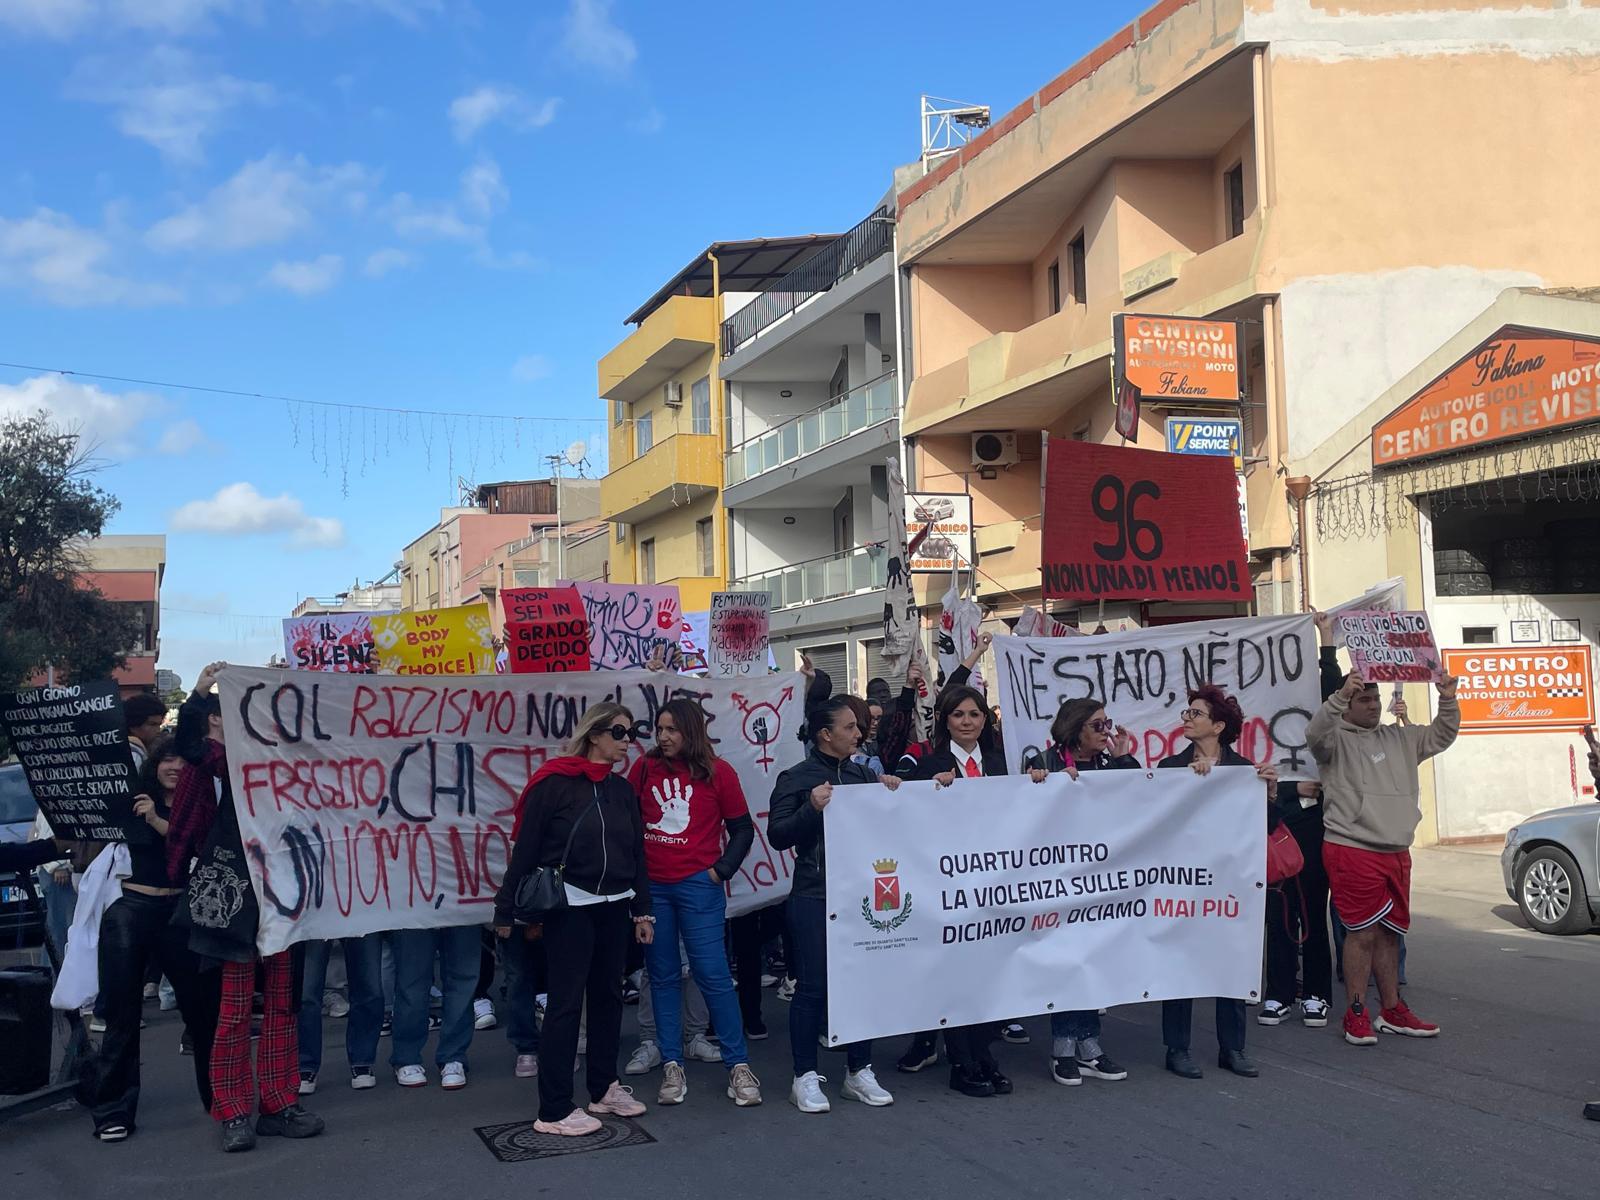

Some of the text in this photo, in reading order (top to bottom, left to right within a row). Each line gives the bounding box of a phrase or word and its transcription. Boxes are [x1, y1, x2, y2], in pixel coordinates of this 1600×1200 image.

[1138, 321, 1224, 342] CENTRO
[1129, 338, 1234, 359] REVISIONI
[1205, 362, 1235, 372] MOTO
[1472, 343, 1546, 386] Fabiana
[1157, 371, 1208, 395] Fabiana
[1420, 380, 1534, 422] AUTOVEICOLI
[1193, 425, 1236, 438] POINT
[1379, 412, 1489, 459] CENTRO
[1188, 438, 1230, 450] SERVICE
[1091, 474, 1163, 561] 96
[1043, 560, 1240, 594] NON UNA DI MENO!
[415, 615, 438, 628] MY
[514, 603, 571, 621] SEI IN
[320, 623, 338, 641] IL
[406, 628, 450, 646] BODY
[519, 620, 585, 641] GRADO
[422, 644, 445, 659] MY
[517, 639, 587, 661] DECIDO
[1393, 649, 1414, 663] UN
[397, 652, 475, 675] CHOICE!
[720, 664, 734, 675] SEI
[1053, 648, 1176, 708] STATO,
[1237, 633, 1303, 690] DIO
[1465, 656, 1569, 672] CENTRO
[1457, 672, 1582, 690] REVISIONI
[16, 690, 40, 705] OGNI
[74, 694, 115, 715] SANGUE
[1456, 690, 1537, 700] AUTOVEICOLI
[240, 682, 332, 747] COL
[1487, 700, 1552, 719] Fabiana
[86, 781, 114, 795] SENZA
[114, 779, 129, 793] MA
[390, 737, 476, 822] CHI
[74, 826, 87, 838] LA
[643, 832, 689, 845] UNIVERSITY
[328, 820, 445, 917] UOMO,
[939, 843, 1108, 878] QUARTU CONTRO
[942, 866, 1213, 911] LA VIOLENZA SULLE DONNE:
[942, 893, 1239, 945] DICIAMO NO, DICIAMO MAI PIÙ
